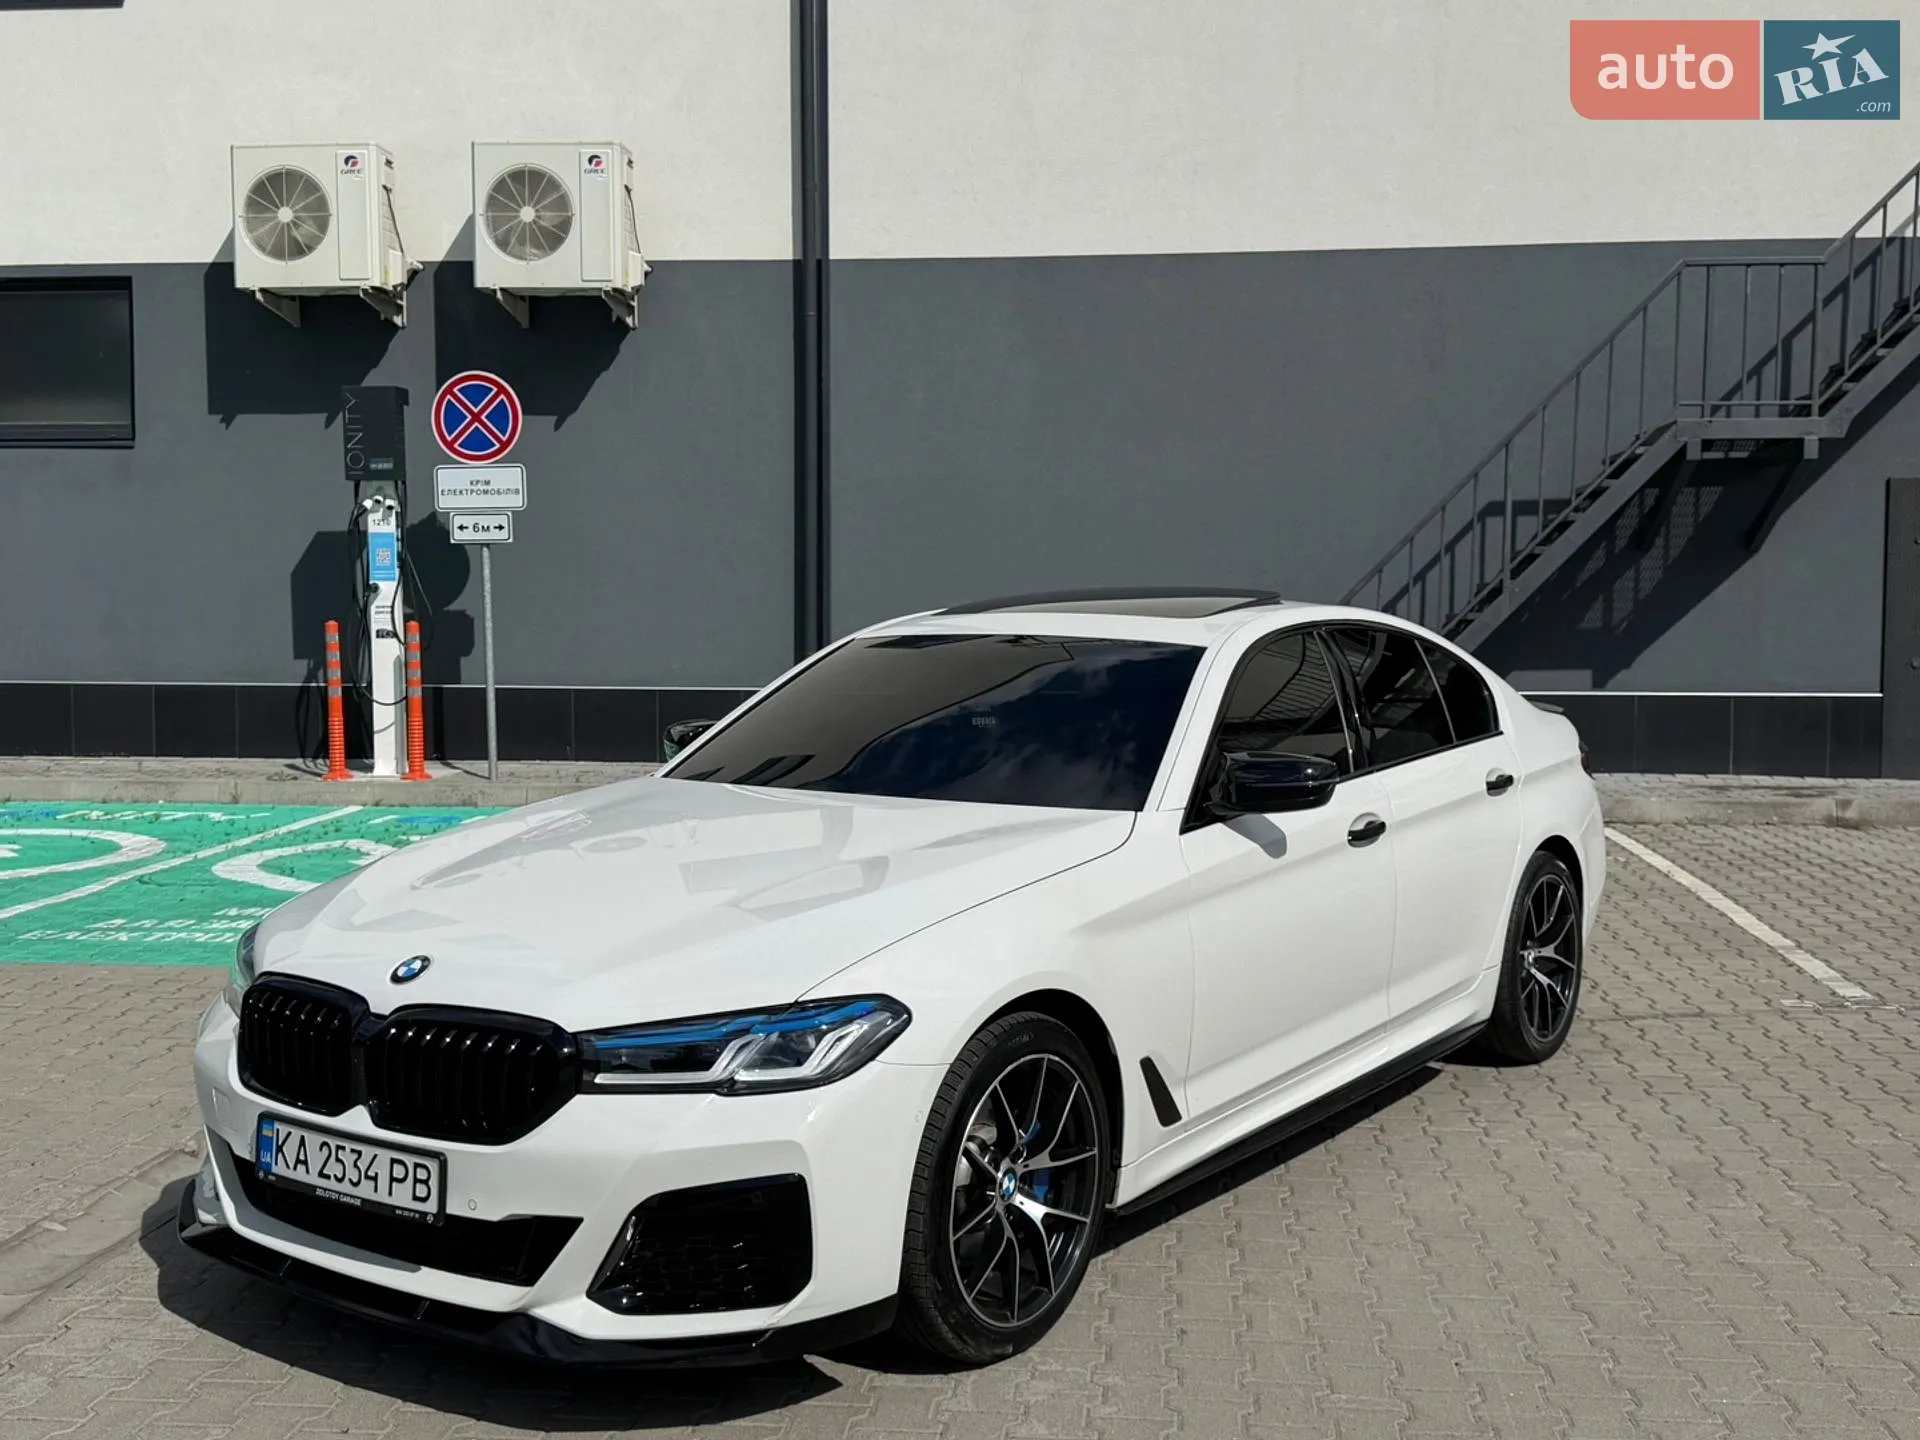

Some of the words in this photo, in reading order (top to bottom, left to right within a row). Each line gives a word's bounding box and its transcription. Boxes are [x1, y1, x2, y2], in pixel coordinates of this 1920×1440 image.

[345, 391, 365, 475] IONITY
[469, 479, 491, 487] КРІМ
[440, 487, 521, 497] ЕЛЕКТРОМОБІЛІВ
[260, 1150, 272, 1163] UA
[274, 1127, 311, 1175] KA
[317, 1140, 380, 1195] 2534
[388, 1156, 432, 1204] PB
